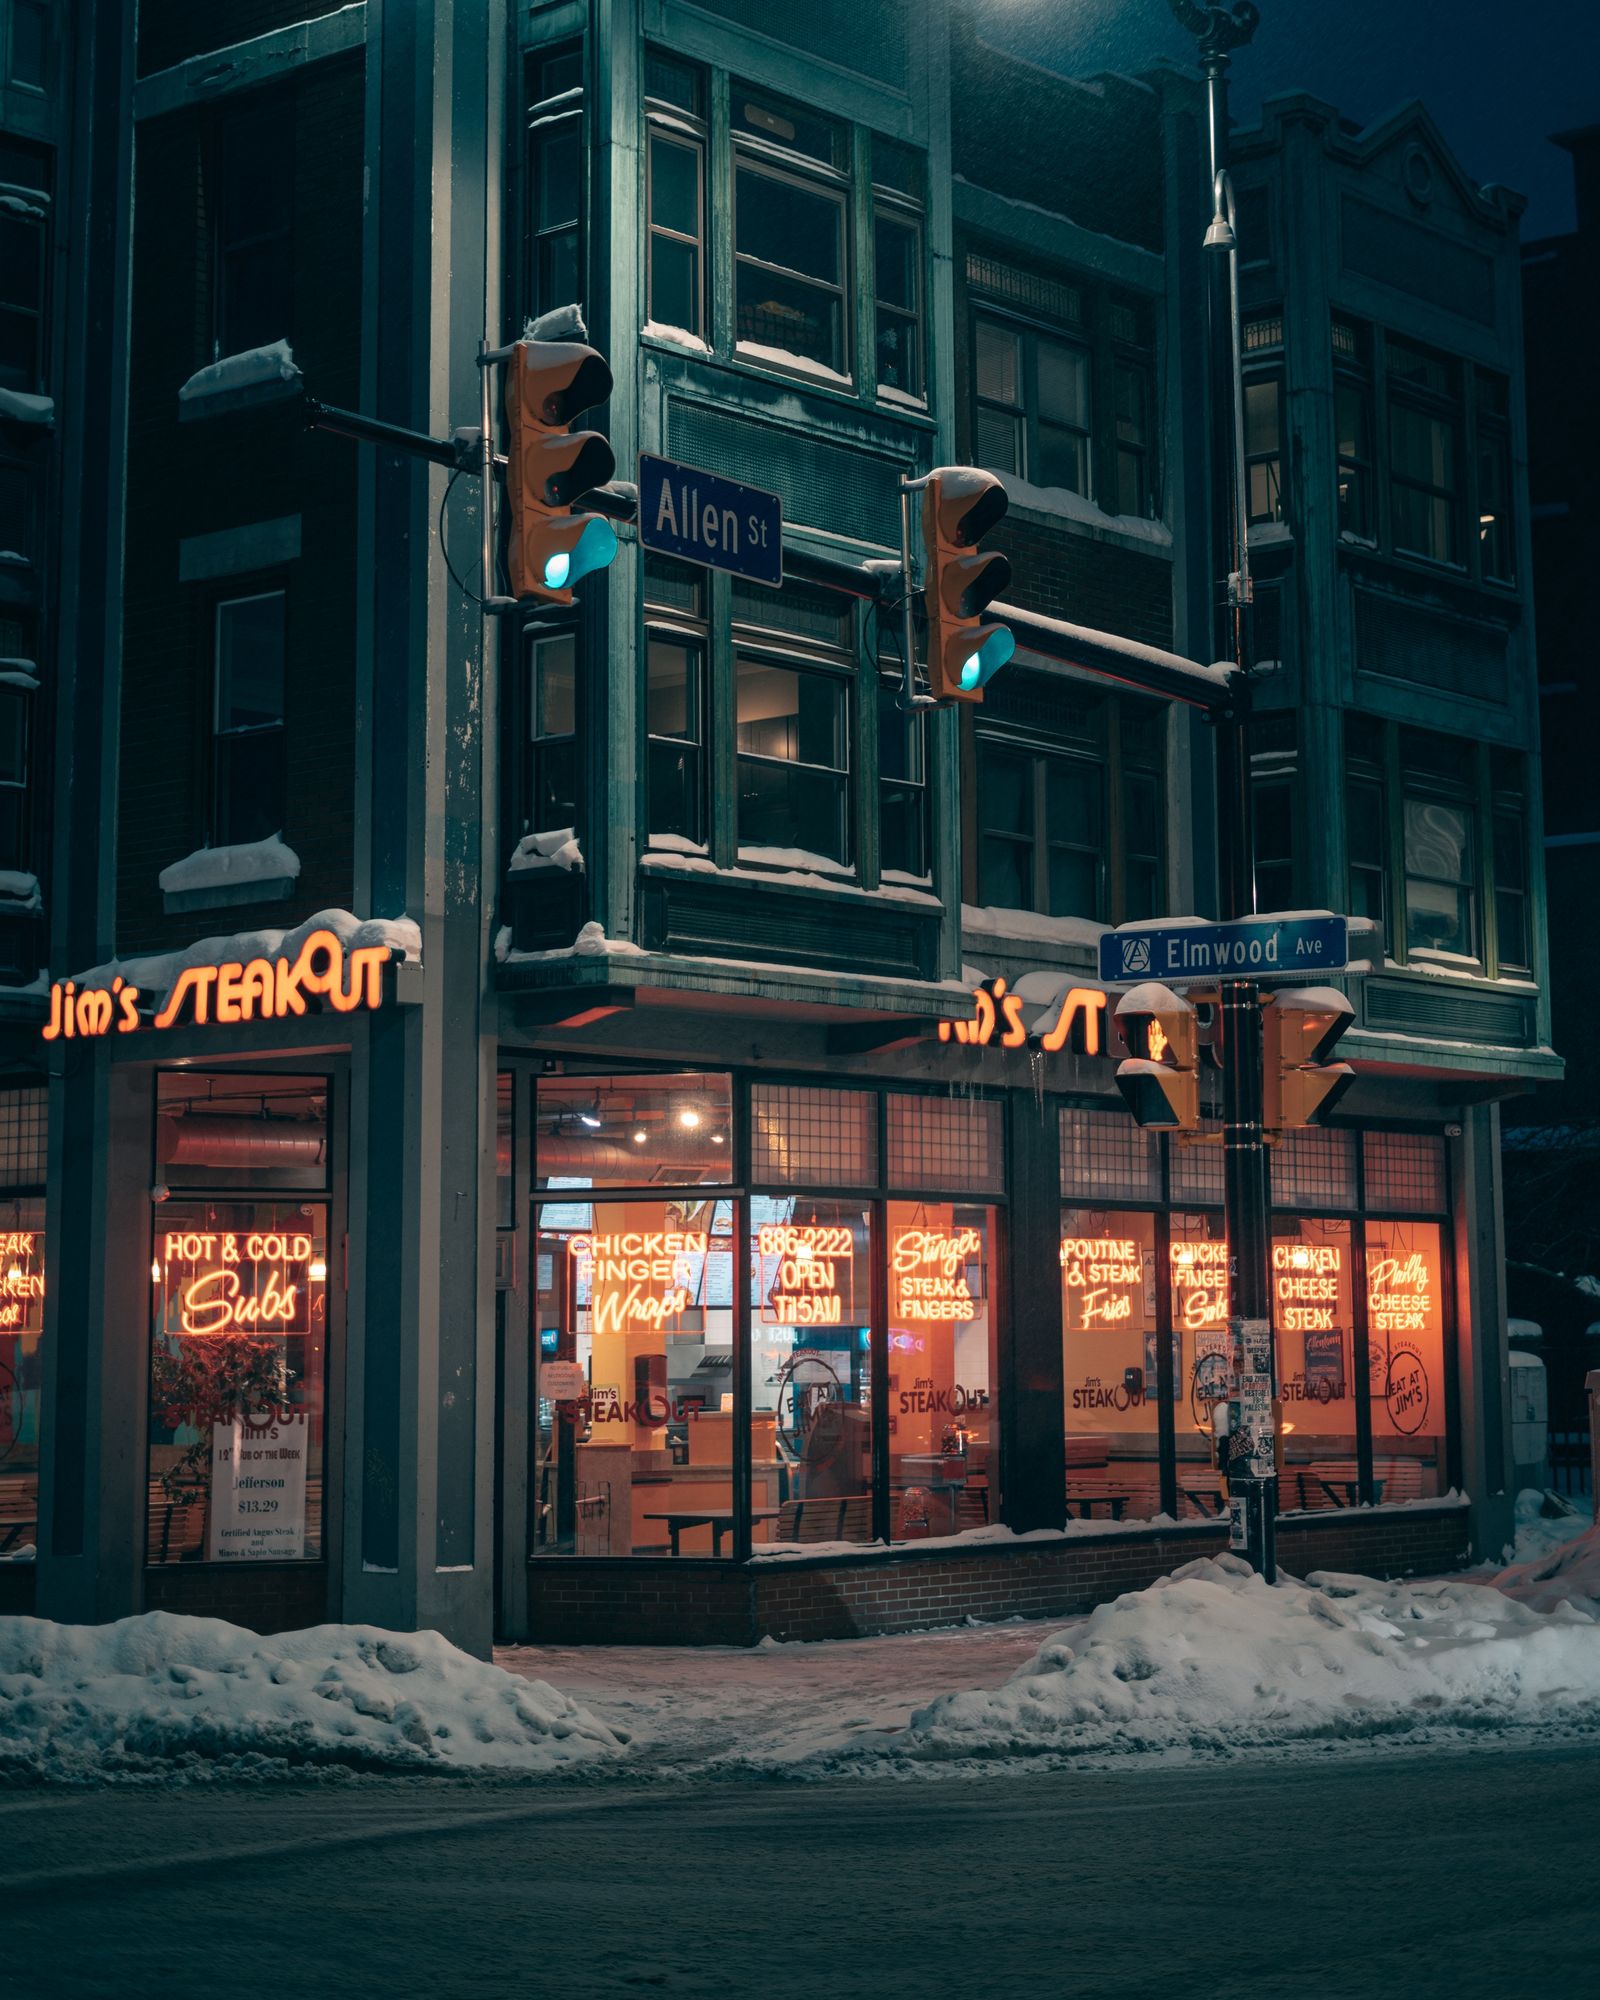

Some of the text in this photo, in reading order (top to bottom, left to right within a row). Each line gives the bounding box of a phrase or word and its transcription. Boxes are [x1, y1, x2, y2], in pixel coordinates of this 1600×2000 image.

[656, 477, 768, 555] Allen St
[1167, 933, 1278, 969] Elmwood
[1296, 937, 1323, 956] Ave
[42, 929, 391, 1040] Jim's STEAKOUT
[166, 1234, 311, 1263] HOT & COLD
[568, 1232, 708, 1258] CHICKEN
[1063, 1239, 1137, 1262] POUTINE
[1169, 1242, 1229, 1264] CHICKE
[578, 1258, 692, 1282] FINGER
[1273, 1246, 1341, 1271] CHCKEN
[0, 1274, 45, 1298] KEN
[781, 1260, 835, 1290] OPEN
[1067, 1261, 1142, 1287] & STEAK
[1174, 1270, 1229, 1287] FINGE
[1369, 1253, 1430, 1294] Philly
[901, 1277, 971, 1299] STEAK &
[1278, 1277, 1339, 1300] CHEESE
[182, 1269, 298, 1335] Subs
[593, 1283, 686, 1334] Wraps
[901, 1299, 975, 1320] FINGERS
[1079, 1287, 1132, 1330] Fries
[1369, 1293, 1432, 1312] CHEESE
[1284, 1307, 1334, 1330] STEAK
[1376, 1312, 1425, 1330] STEAK
[588, 1387, 617, 1400] Jim's
[913, 1377, 934, 1390] Jim's
[1084, 1376, 1101, 1388] Jim's
[1282, 1377, 1347, 1405] STEAKOUT
[1390, 1369, 1420, 1396] EAT AT
[899, 1384, 986, 1416] STEAKOUT
[1072, 1383, 1147, 1412] STEAKOUT
[1396, 1385, 1423, 1415] JIM'S
[564, 1395, 704, 1428] STEAKOUT
[233, 1476, 285, 1491] Jefferson
[237, 1500, 279, 1514] $13.29
